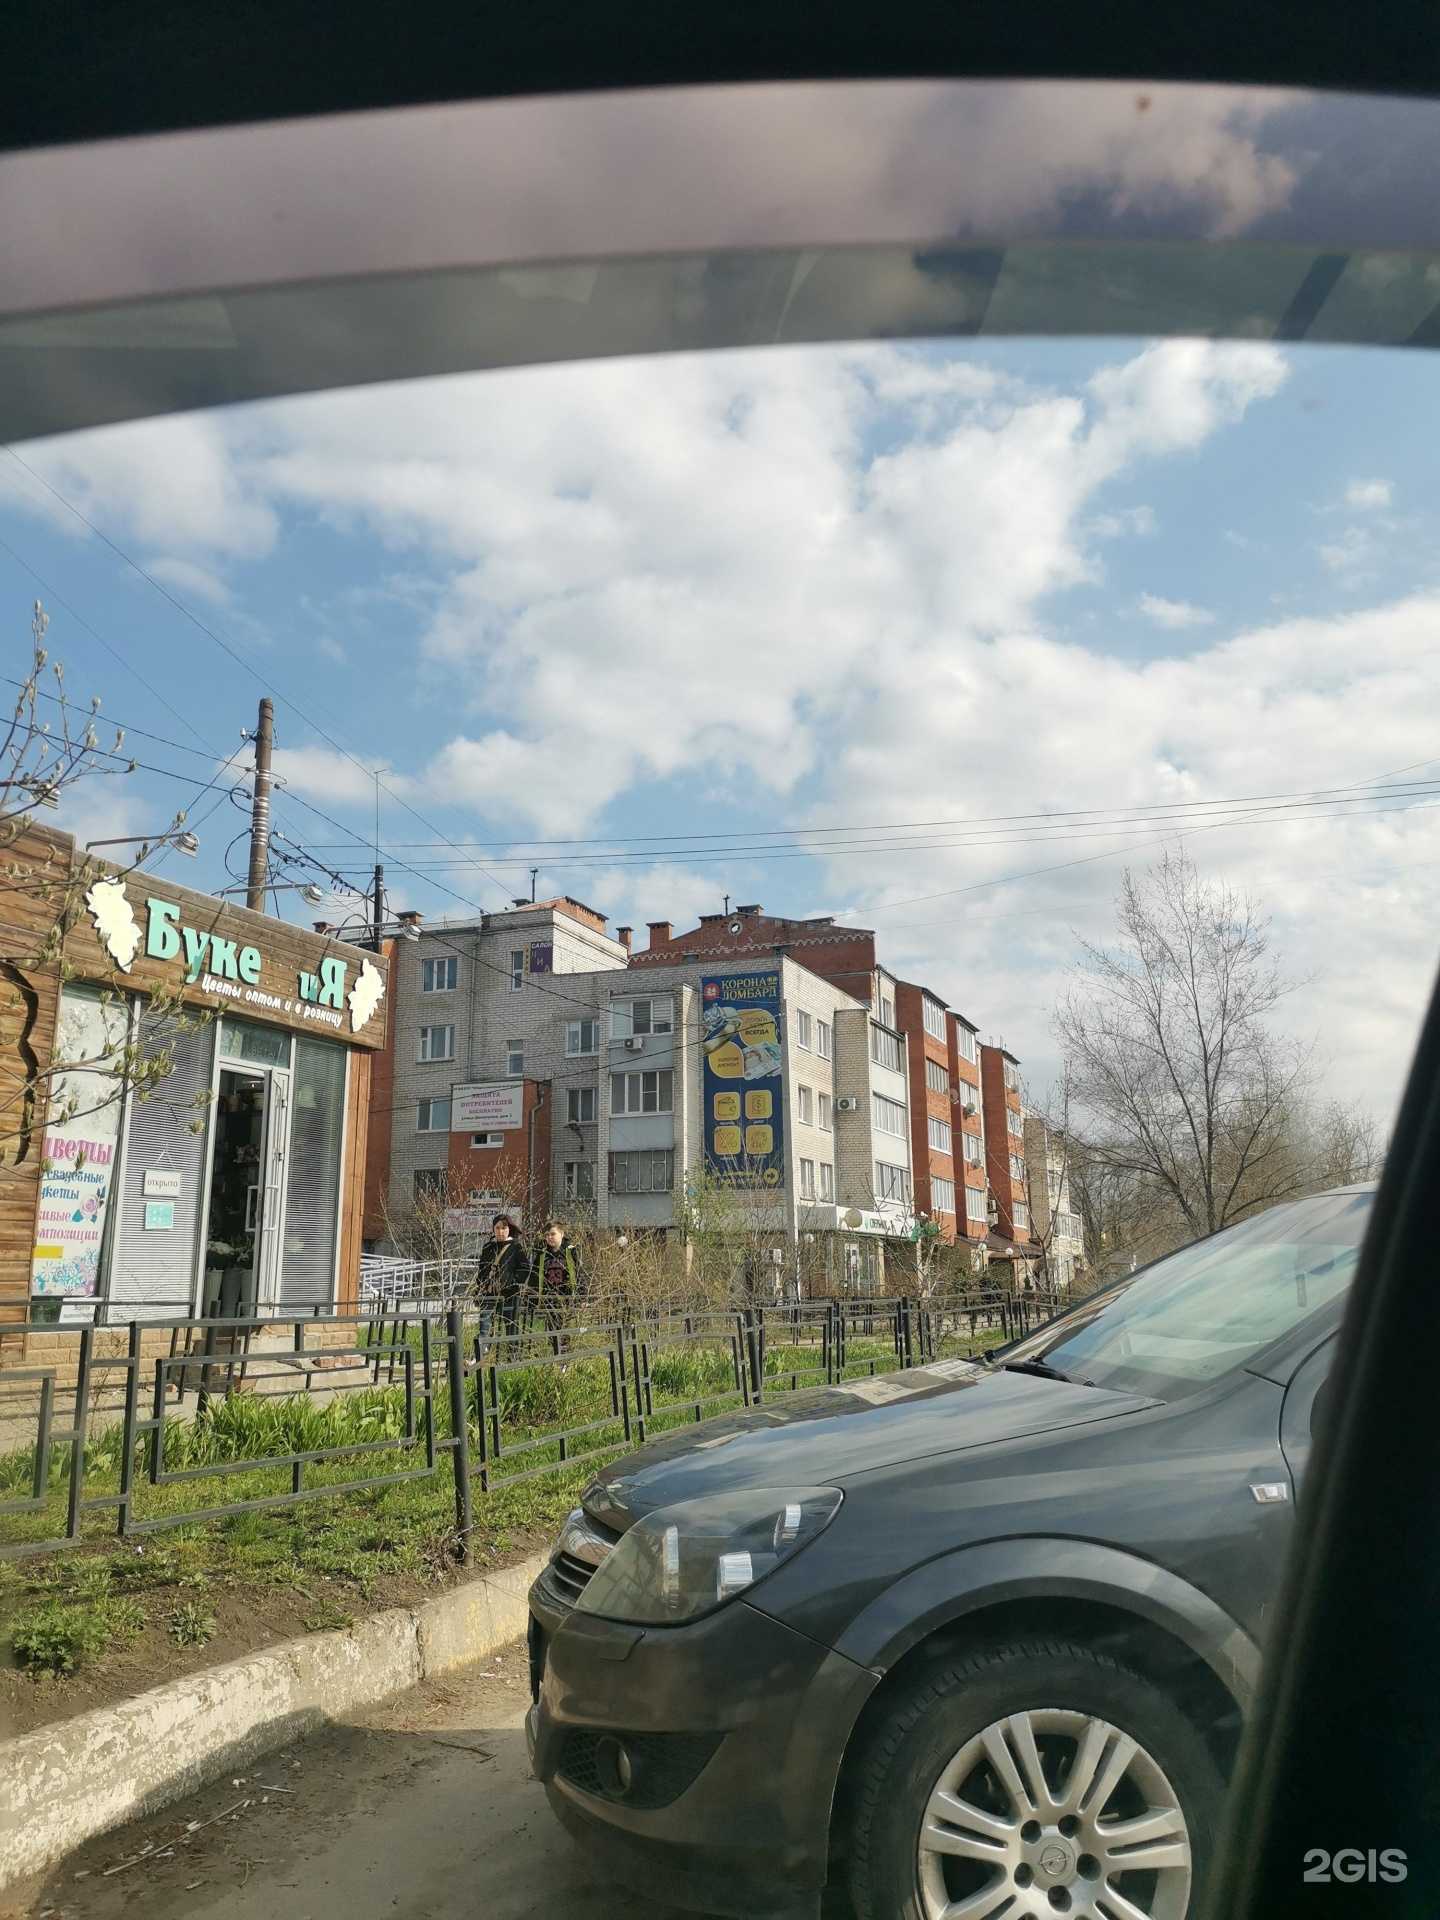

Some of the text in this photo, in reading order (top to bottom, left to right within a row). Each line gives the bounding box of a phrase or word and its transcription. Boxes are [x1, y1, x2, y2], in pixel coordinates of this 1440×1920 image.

[721, 976, 767, 990] КОРОНА
[722, 986, 777, 1000] ЛОМБАРД
[201, 973, 343, 1028] Цветы оптом и в розницу
[147, 1179, 178, 1189] открыто
